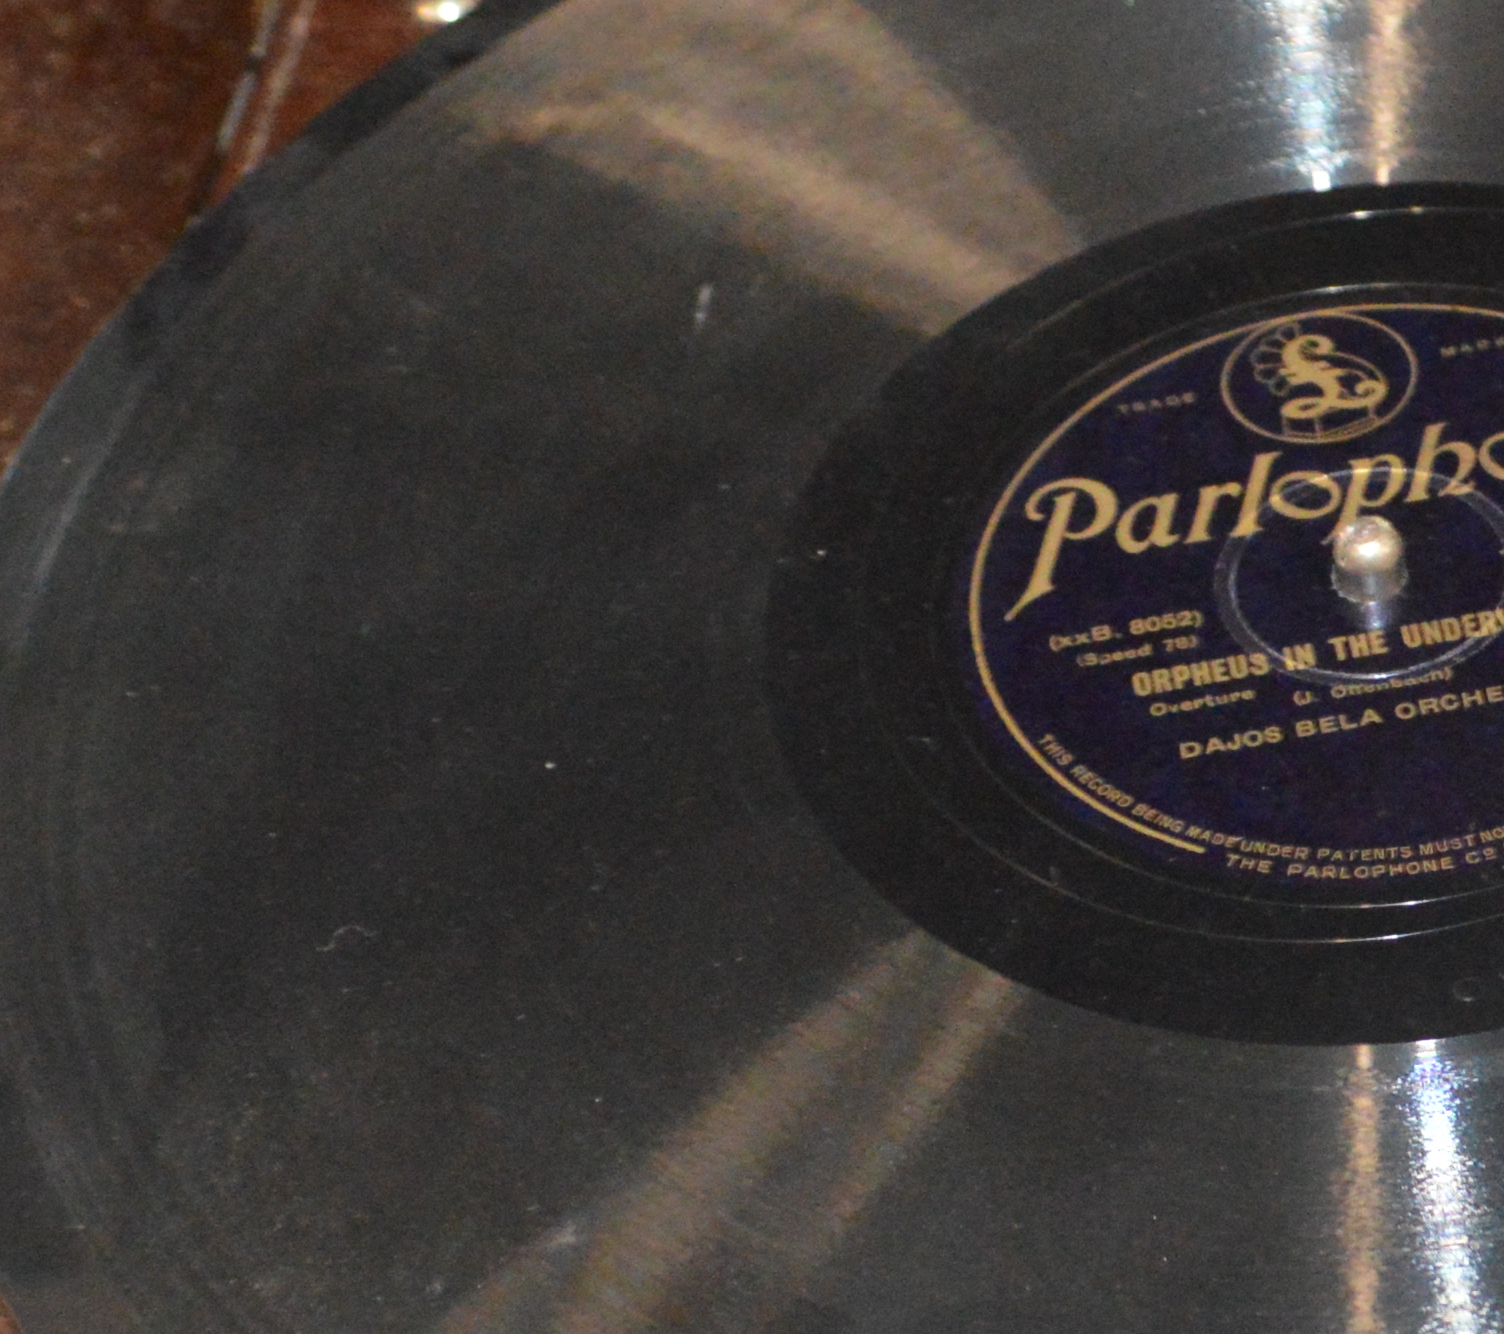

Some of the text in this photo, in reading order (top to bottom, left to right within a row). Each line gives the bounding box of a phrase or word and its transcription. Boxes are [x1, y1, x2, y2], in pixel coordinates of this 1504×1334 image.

[1117, 391, 1195, 415] TRADE
[1128, 609, 1204, 637] 8052)
[1075, 642, 1153, 668] (Speed
[1131, 652, 1270, 696] ORPHEUS
[1282, 642, 1317, 671] IN
[1327, 629, 1389, 662] THE
[1148, 687, 1257, 717] Overture
[1178, 725, 1285, 759] DAJOS
[1295, 707, 1385, 738] BELA
[1037, 732, 1075, 767] THIS
[1069, 763, 1132, 808] RECORD
[1130, 801, 1184, 834] BEING
[1184, 825, 1243, 848] MADE
[1241, 841, 1309, 860] UNDER
[1317, 845, 1413, 862] PATENTS
[1418, 832, 1477, 855] MUST
[1226, 852, 1273, 874] THE
[1286, 855, 1455, 880] PARLOPHONE
